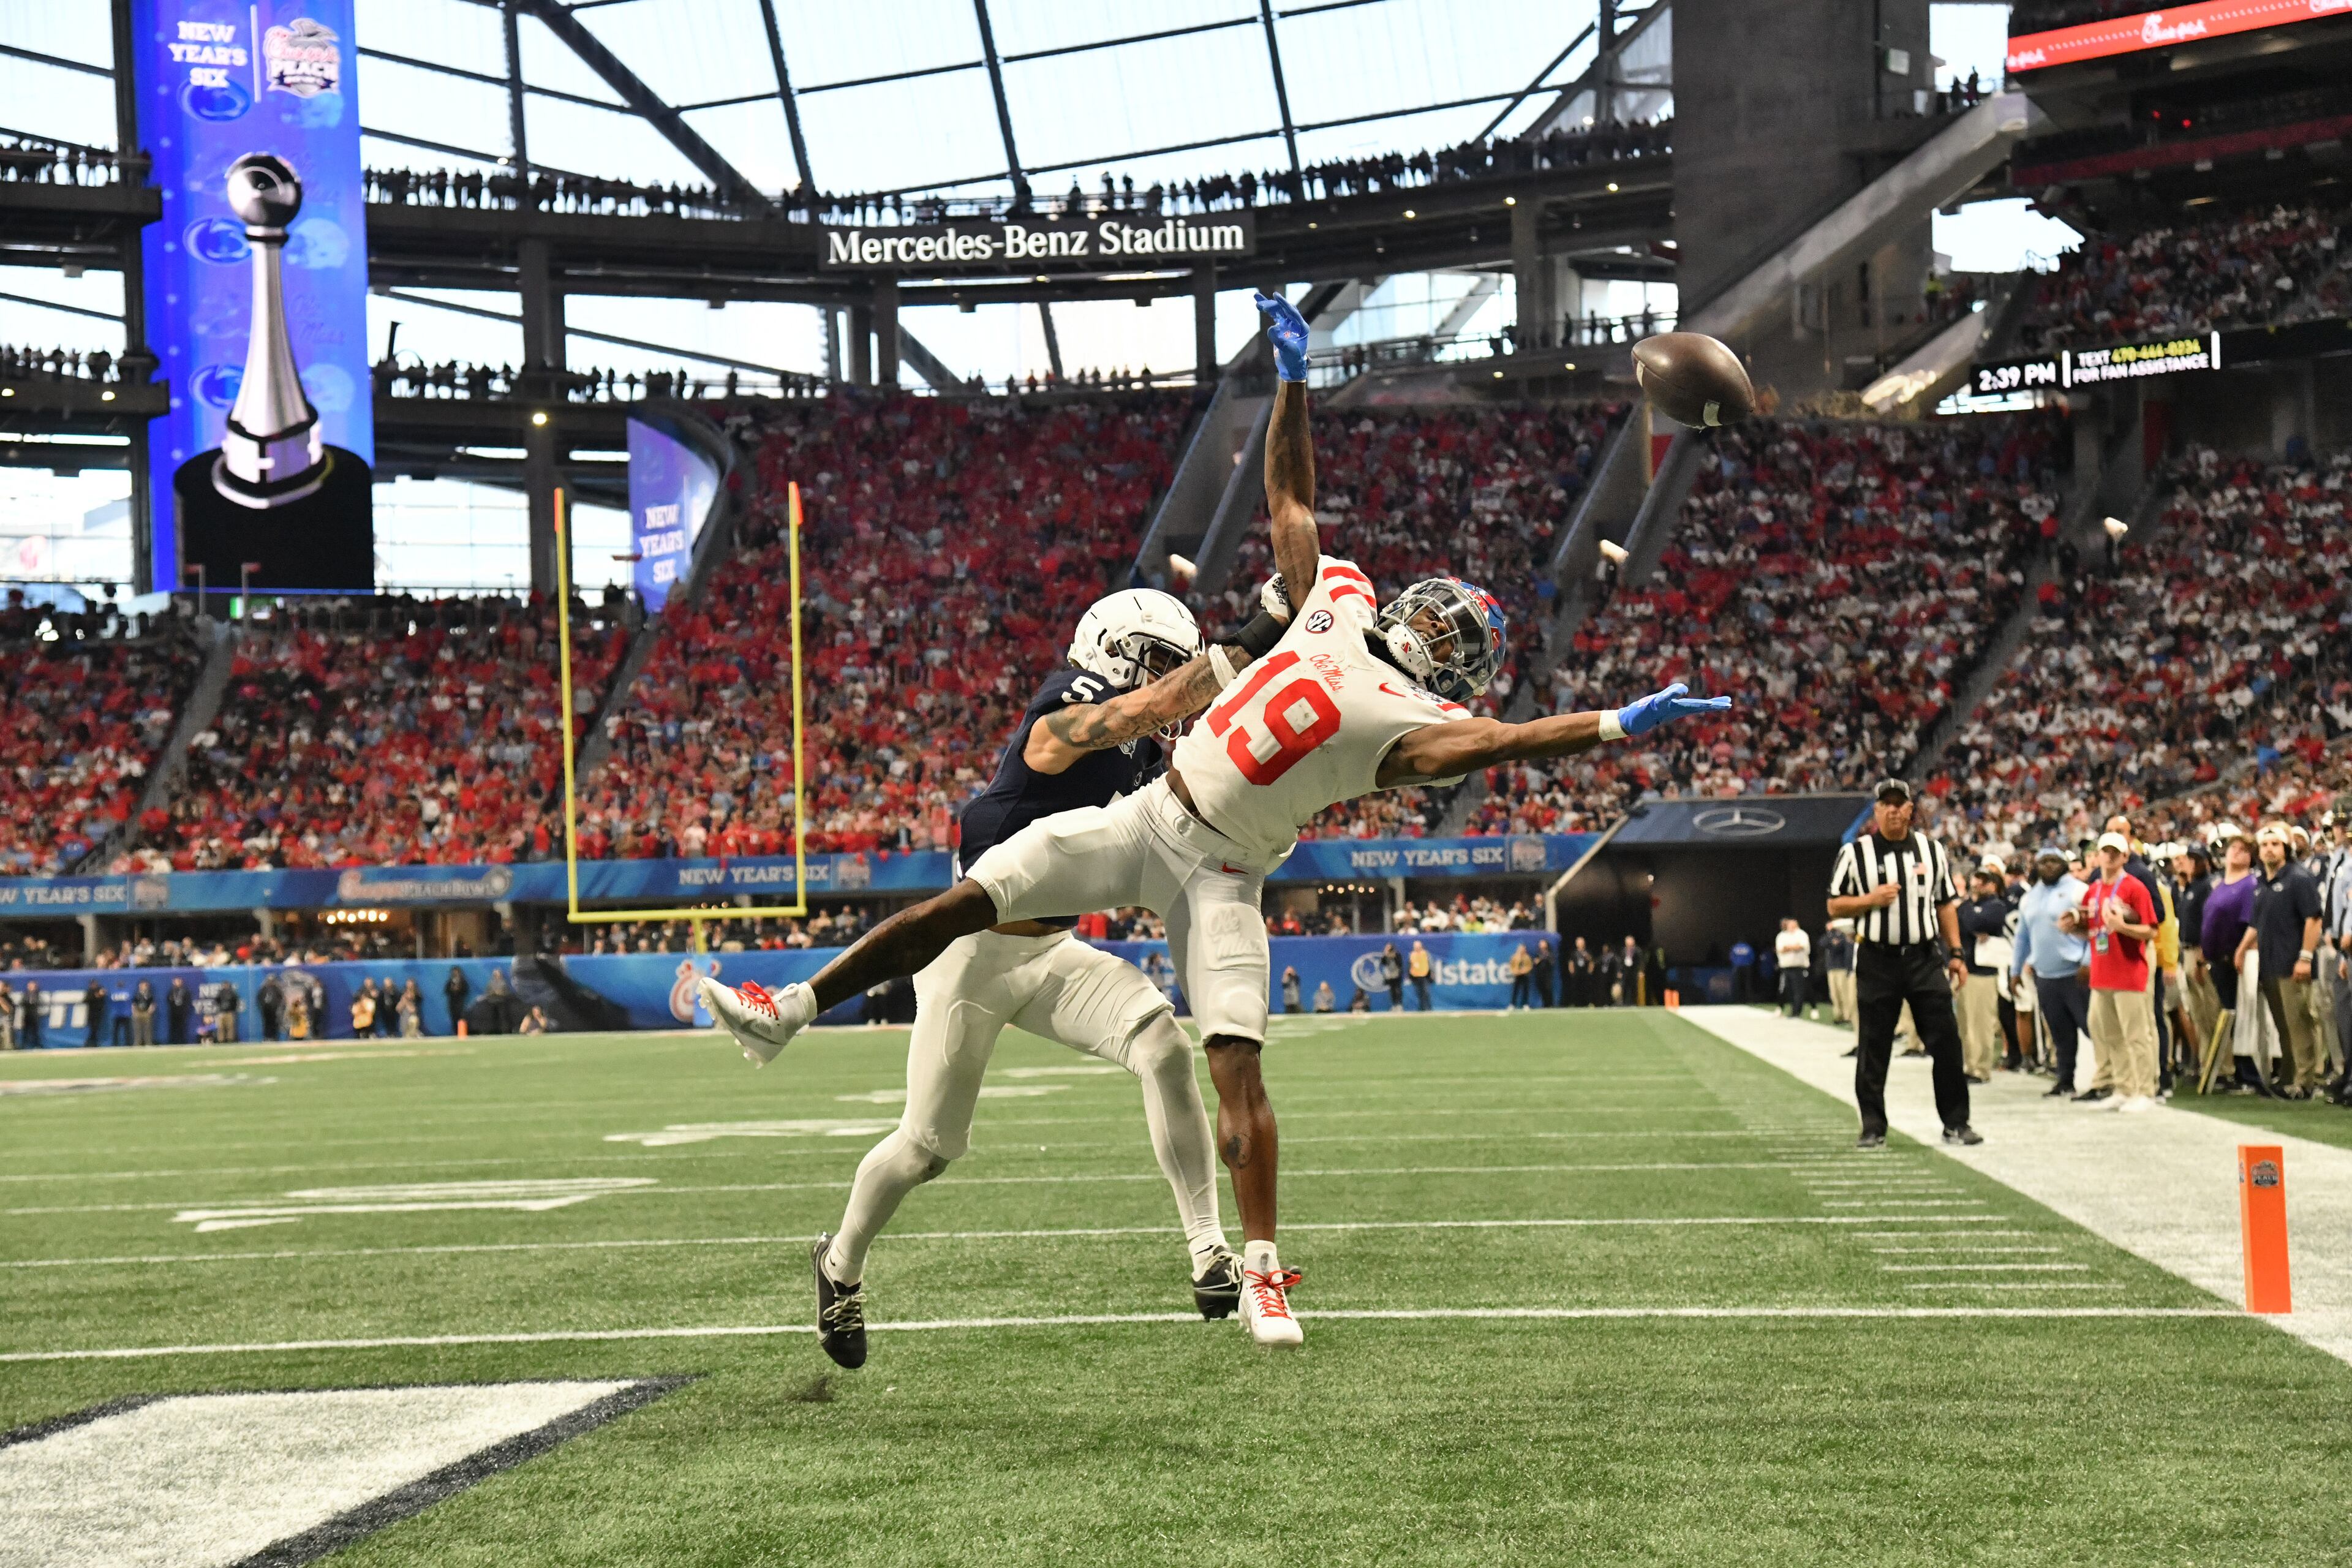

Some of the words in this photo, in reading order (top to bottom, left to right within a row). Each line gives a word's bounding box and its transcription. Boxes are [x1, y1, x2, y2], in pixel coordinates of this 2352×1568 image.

[178, 21, 235, 42] NEW
[168, 43, 247, 66] YEAR'S
[189, 67, 230, 87] SIX
[827, 224, 1090, 265] Mercedes-Benz
[1099, 219, 1245, 256] Stadium
[2073, 366, 2100, 383] FOR
[2100, 363, 2128, 380] FAN
[2128, 353, 2209, 377] ASSISTANCE
[2078, 350, 2111, 366] TEXT
[1979, 366, 2021, 391] 2:39
[2024, 361, 2056, 386] PM
[645, 503, 680, 529] NEW
[652, 559, 676, 583] SIX
[1306, 611, 1332, 631] SEC
[1309, 654, 1335, 670] Ole
[1061, 676, 1104, 703] 5
[1320, 665, 1345, 693] Miss
[1207, 650, 1341, 785] 19
[1351, 850, 1399, 868] NEW
[1403, 848, 1468, 866] YEAR'S
[1472, 846, 1504, 864] SIX
[679, 868, 726, 885] NEW
[730, 865, 794, 883] YEAR'S
[23, 886, 91, 905] YEAR'S
[93, 885, 126, 902] SIX
